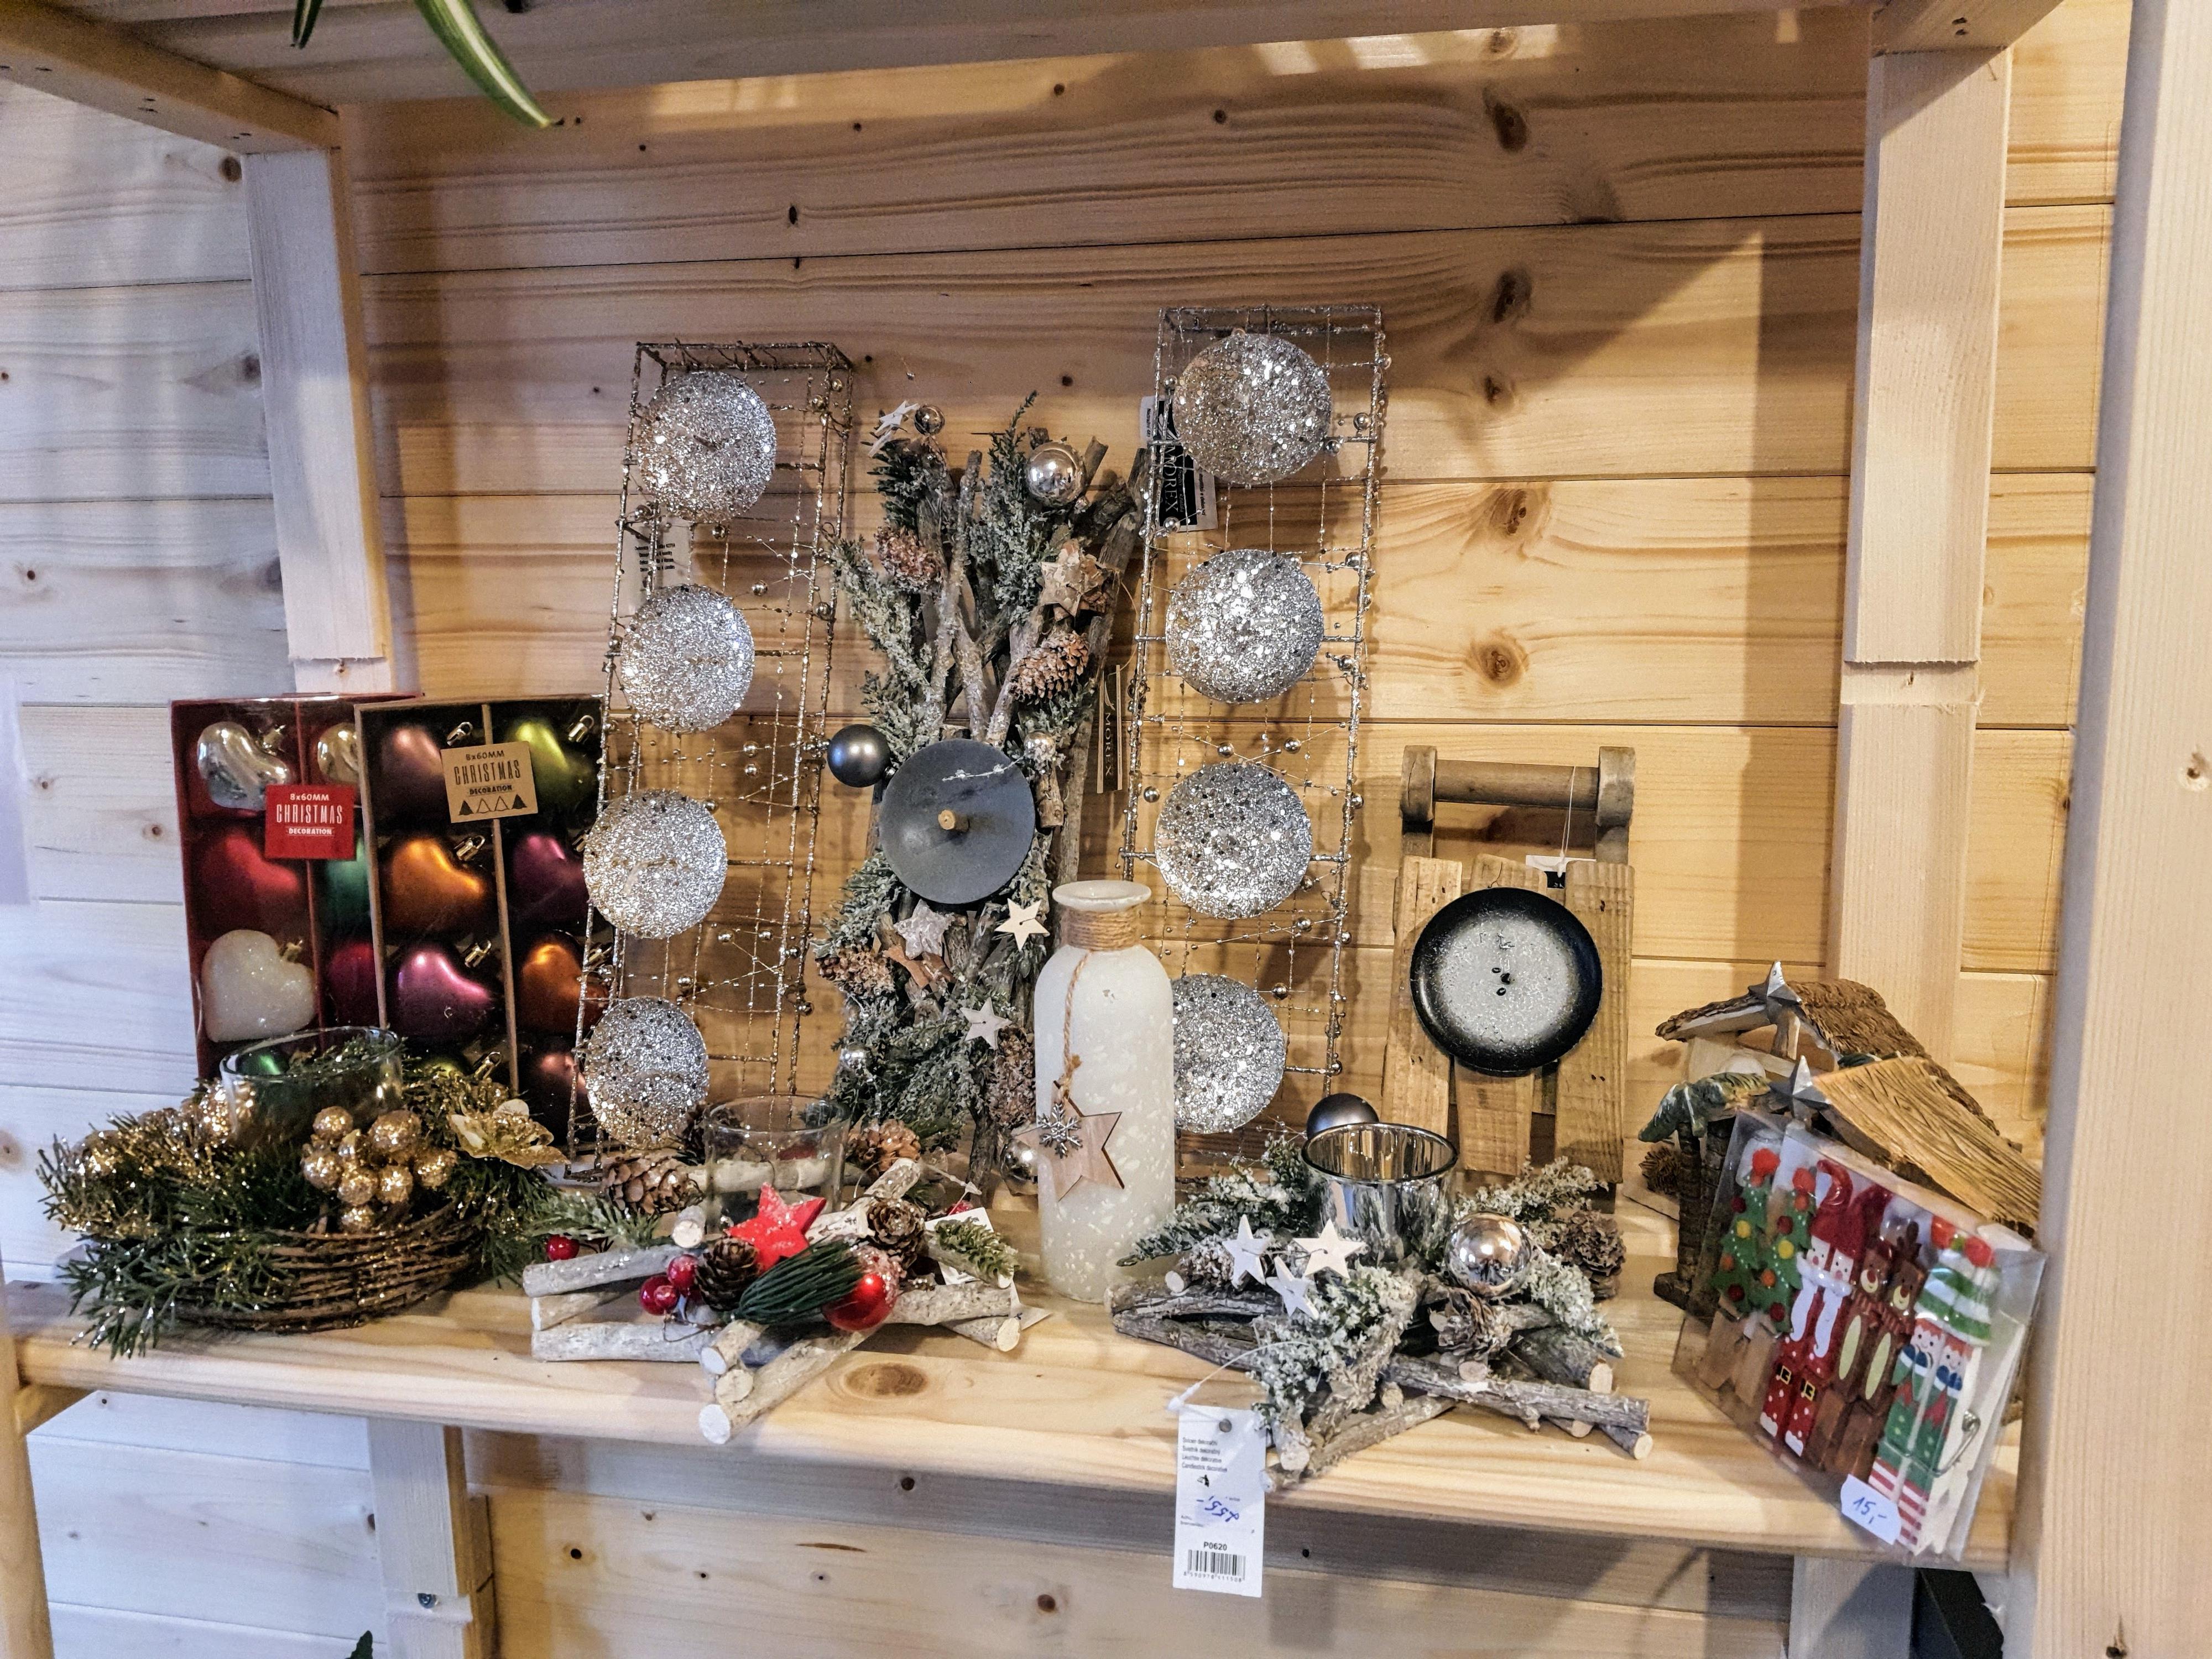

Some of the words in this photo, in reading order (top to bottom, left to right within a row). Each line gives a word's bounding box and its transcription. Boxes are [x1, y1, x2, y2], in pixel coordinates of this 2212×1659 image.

[1164, 445, 1178, 513] MOREX
[465, 750, 505, 761] 8x60MM
[453, 760, 521, 785] CHRISTMAS
[469, 785, 513, 795] DECORATION
[276, 804, 343, 824] CHRISTMAS
[1853, 1496, 1887, 1524] 15,-
[1203, 1541, 1227, 1551] P0620
